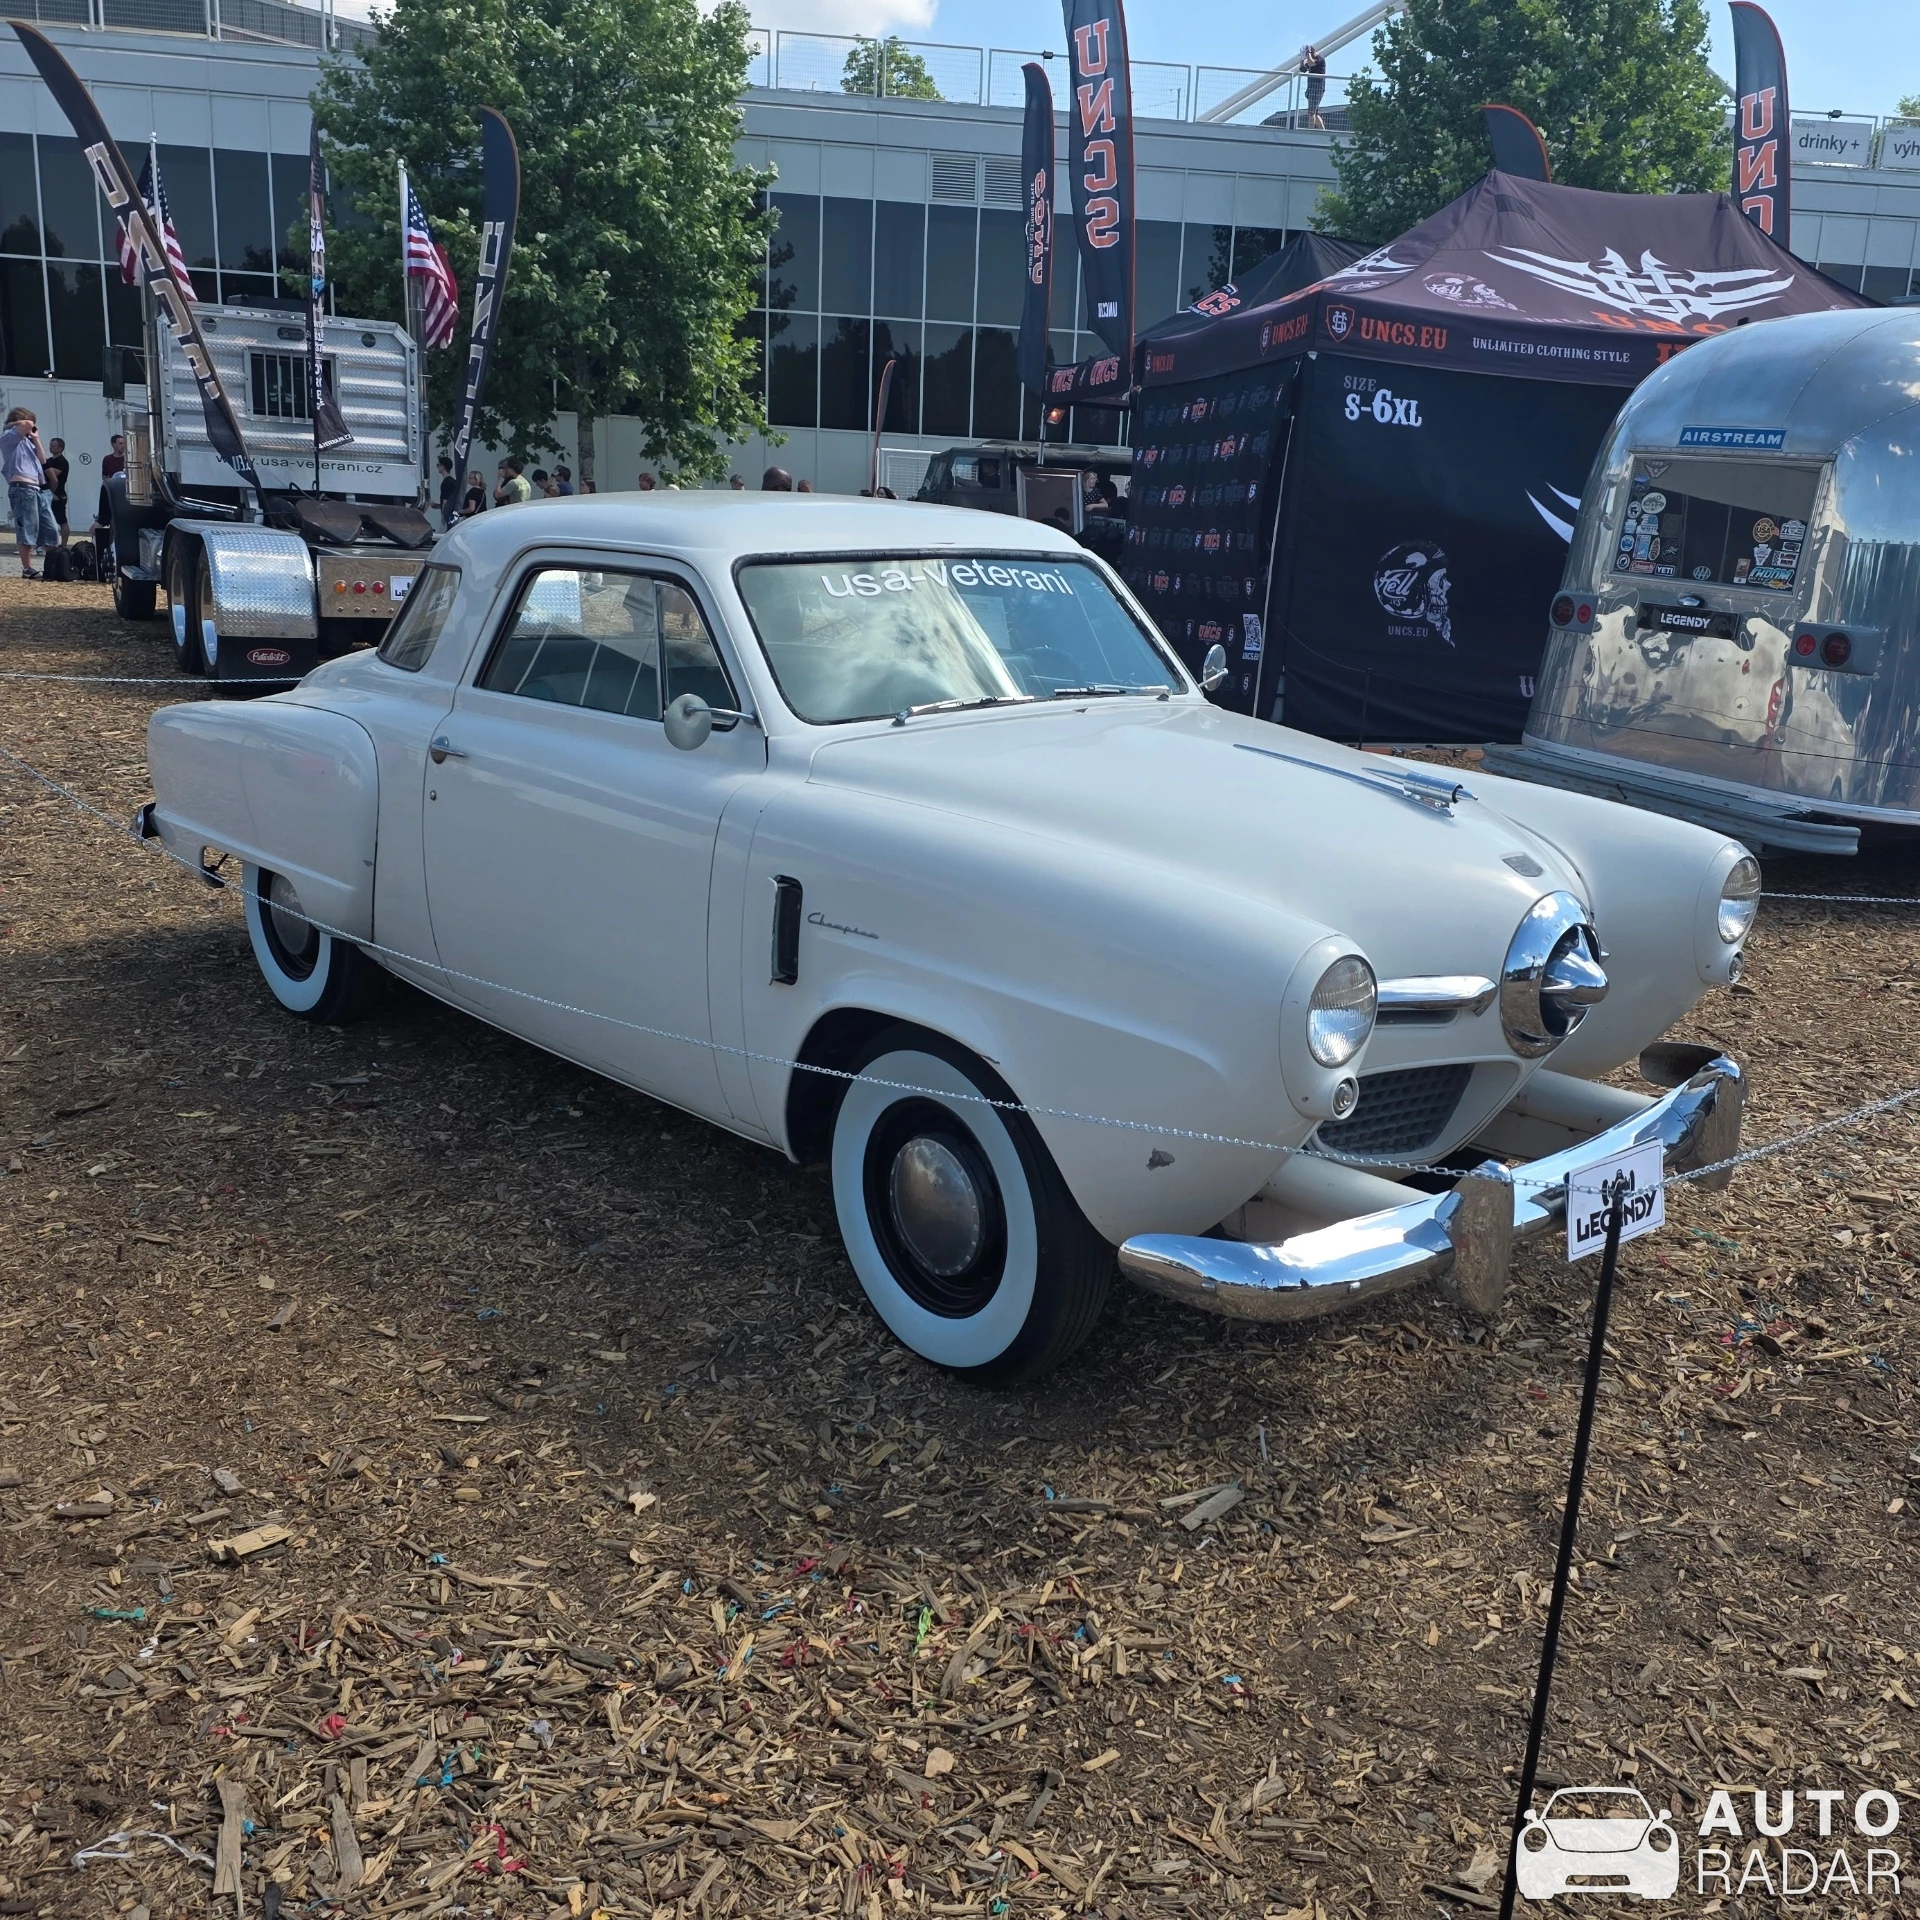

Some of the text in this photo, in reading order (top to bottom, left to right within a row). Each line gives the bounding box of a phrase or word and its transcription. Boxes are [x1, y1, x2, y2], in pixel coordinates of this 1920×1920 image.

[1798, 133, 1848, 155] drinky
[1893, 140, 1920, 159] výh
[1197, 292, 1241, 316] CS
[1272, 314, 1309, 345] UNCS.EU
[1360, 317, 1448, 350] UNCS.EU
[1472, 337, 1630, 363] UNLIMITED CLOTHING STYLE
[1343, 375, 1377, 392] SIZE
[1344, 388, 1423, 427] S-6XL
[1682, 431, 1782, 445] AIRSTREAM
[1756, 526, 1771, 534] USA
[821, 559, 1074, 598] usa-veterani
[1657, 566, 1674, 574] YETI
[1388, 625, 1429, 638] UNCS.EU
[1660, 612, 1711, 629] LEGENDY
[1576, 1189, 1658, 1243] LEGNDY
